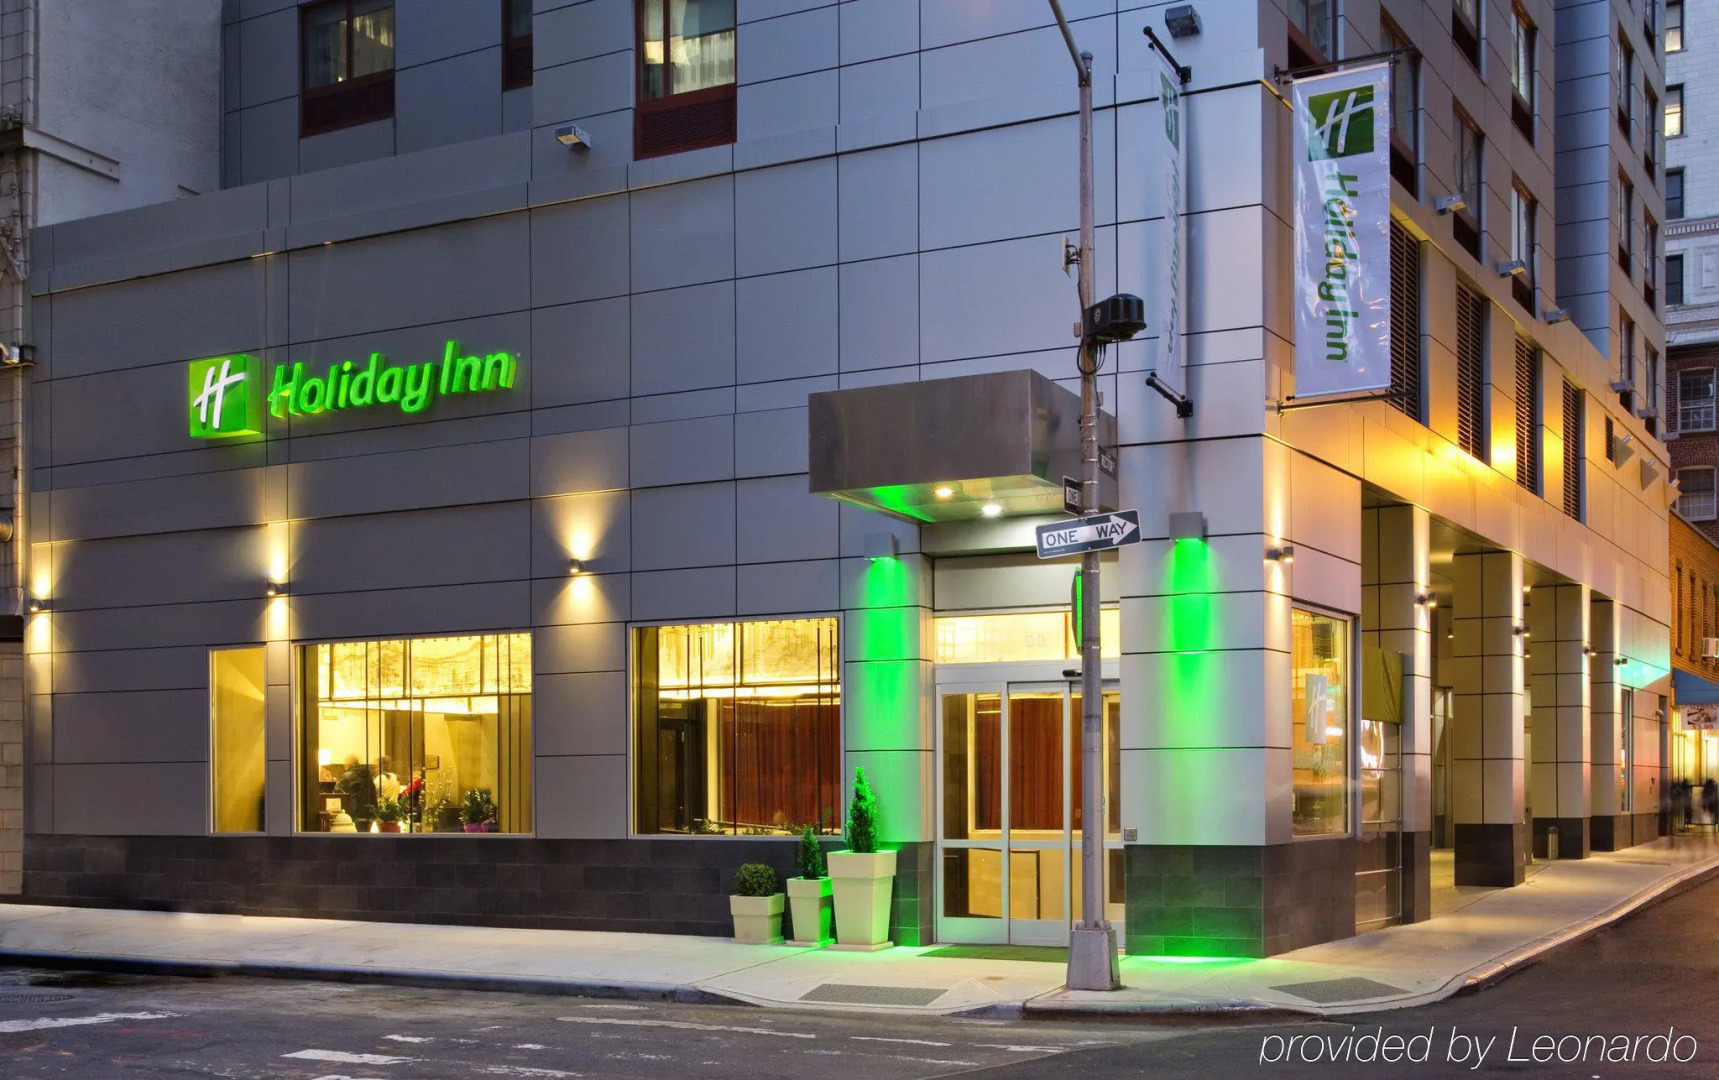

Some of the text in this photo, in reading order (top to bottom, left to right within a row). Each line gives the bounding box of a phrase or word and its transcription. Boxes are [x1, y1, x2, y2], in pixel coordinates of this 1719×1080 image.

[1318, 171, 1360, 361] Holiday Inn
[193, 359, 245, 430] H
[268, 341, 516, 415] Holiday Inn
[1067, 488, 1078, 505] ONE
[1046, 521, 1127, 547] ONE WAY
